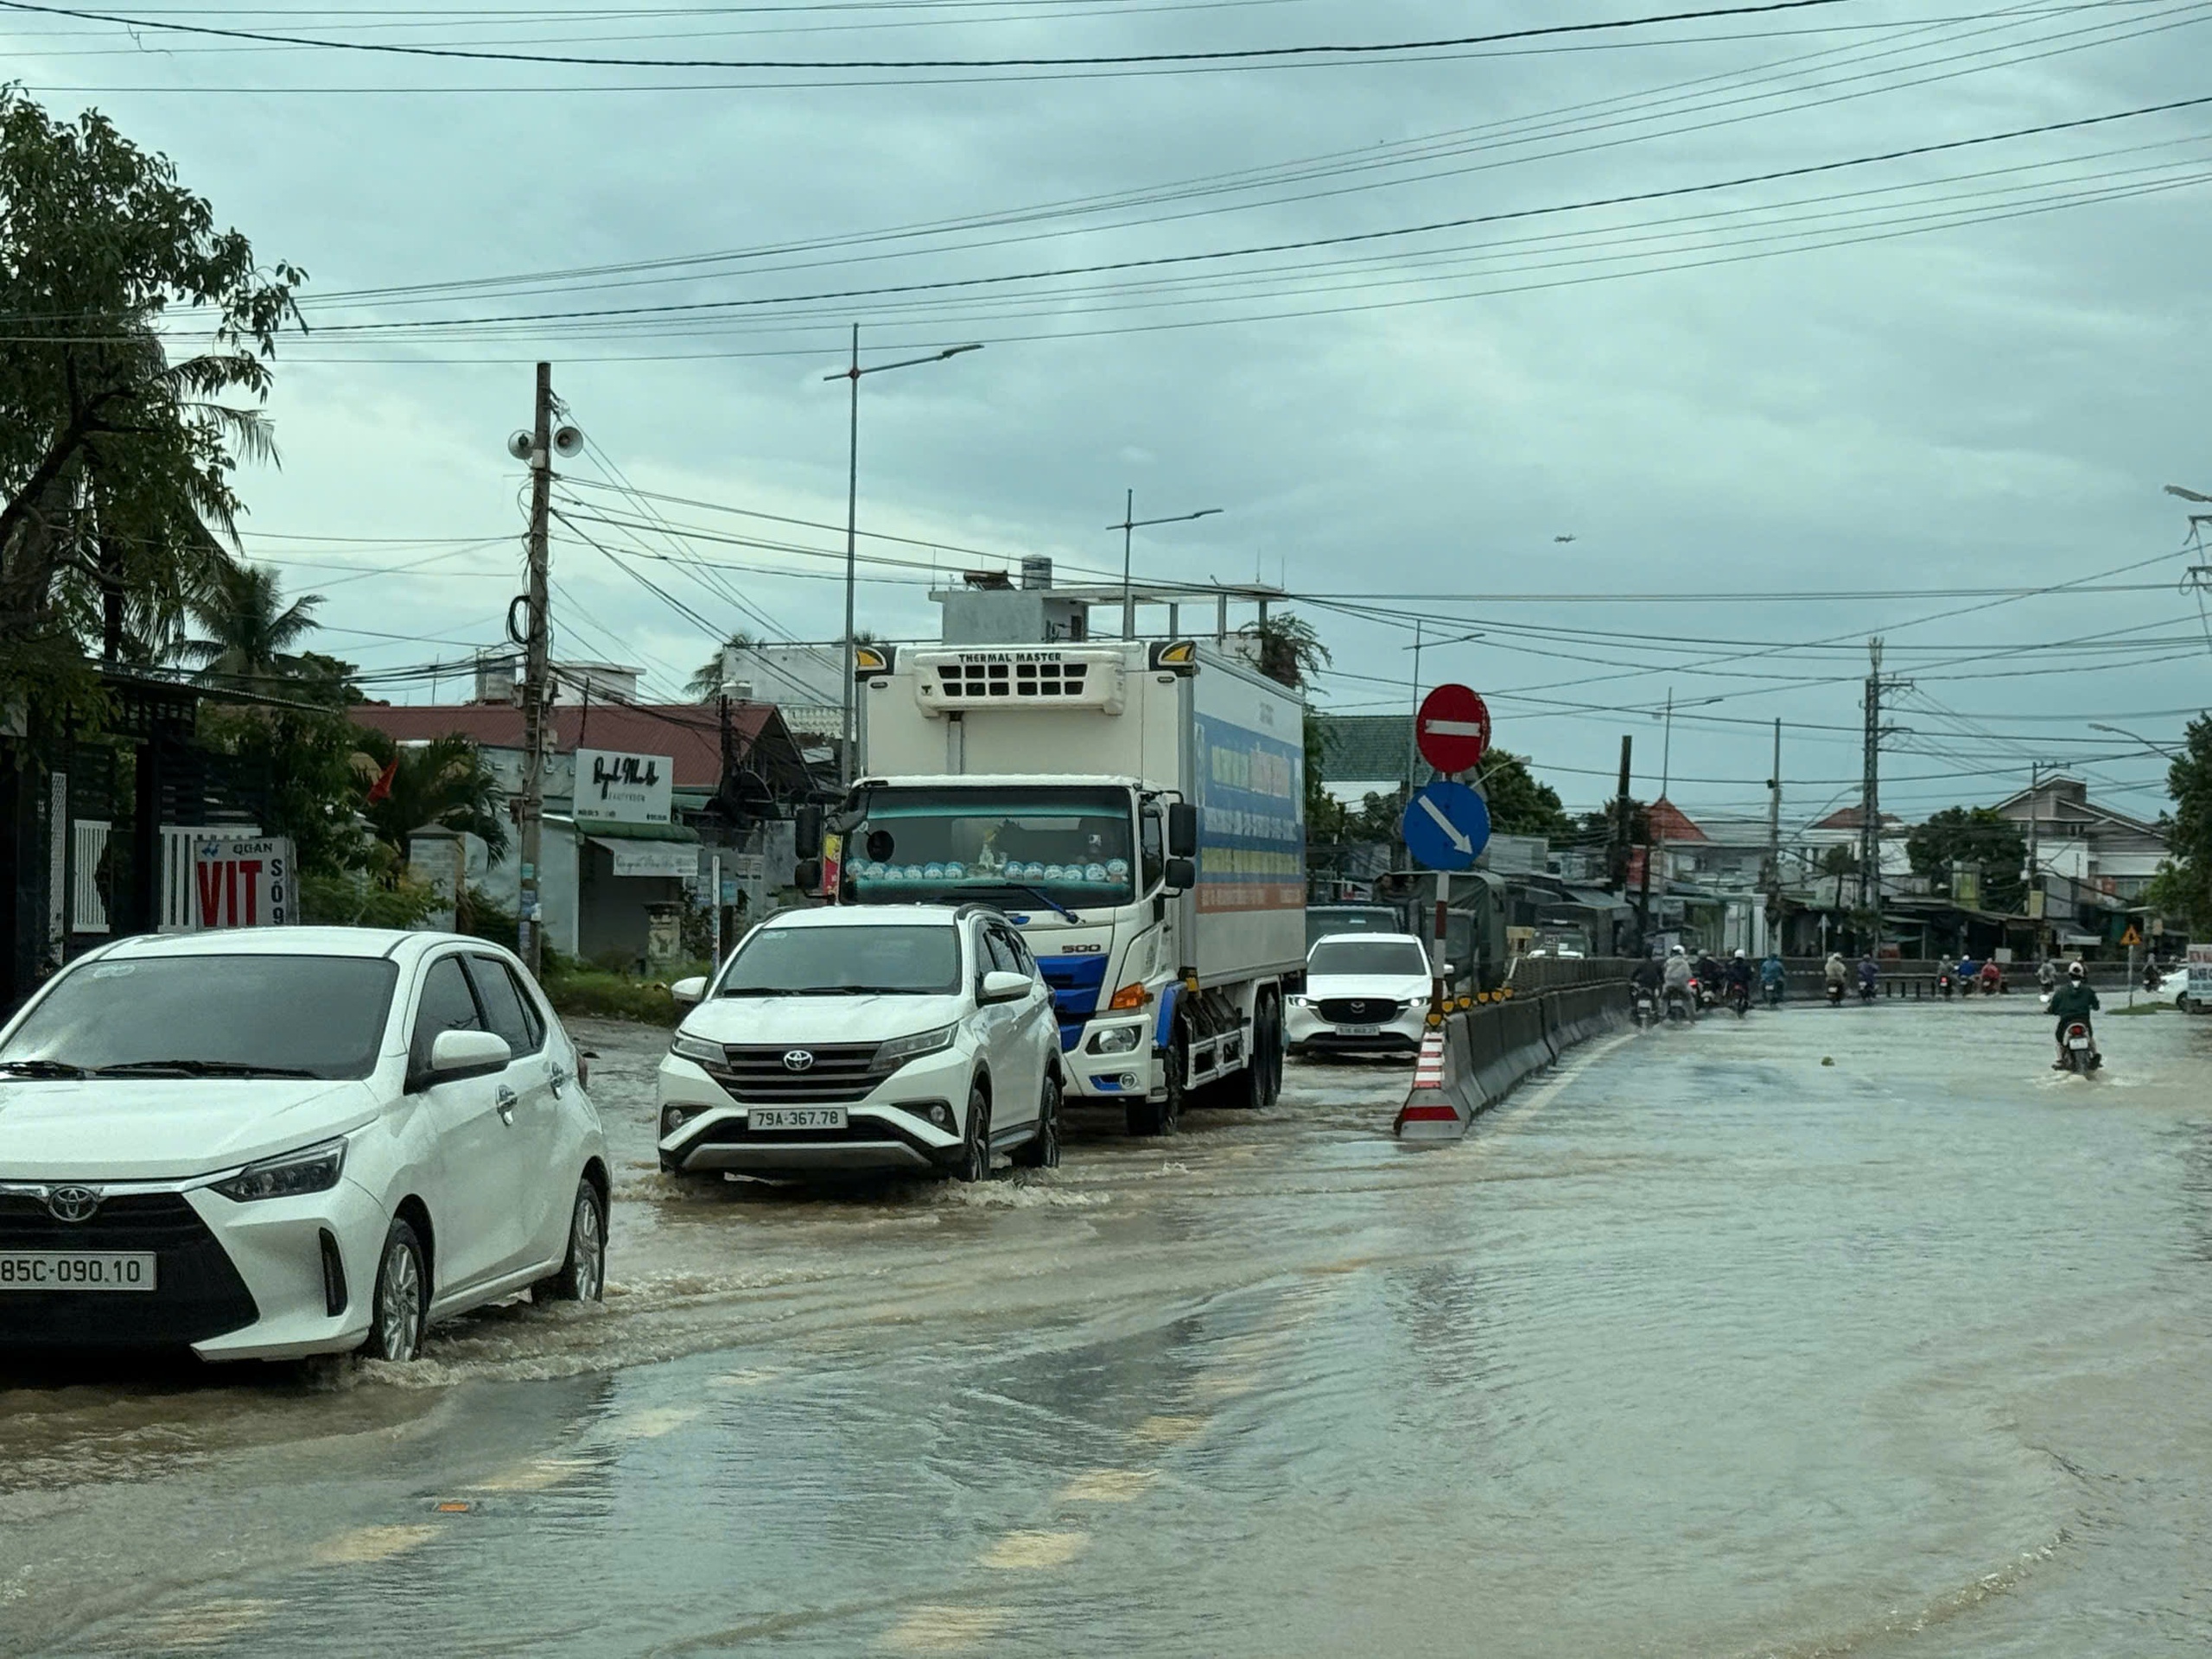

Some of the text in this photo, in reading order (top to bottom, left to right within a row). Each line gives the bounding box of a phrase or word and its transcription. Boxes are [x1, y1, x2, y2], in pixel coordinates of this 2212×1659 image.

[958, 652, 1062, 663] THERMAL MASTER
[1062, 944, 1101, 953] 500
[757, 1111, 838, 1126] 79A-367.78
[2, 1260, 140, 1282] 85C-090.10
